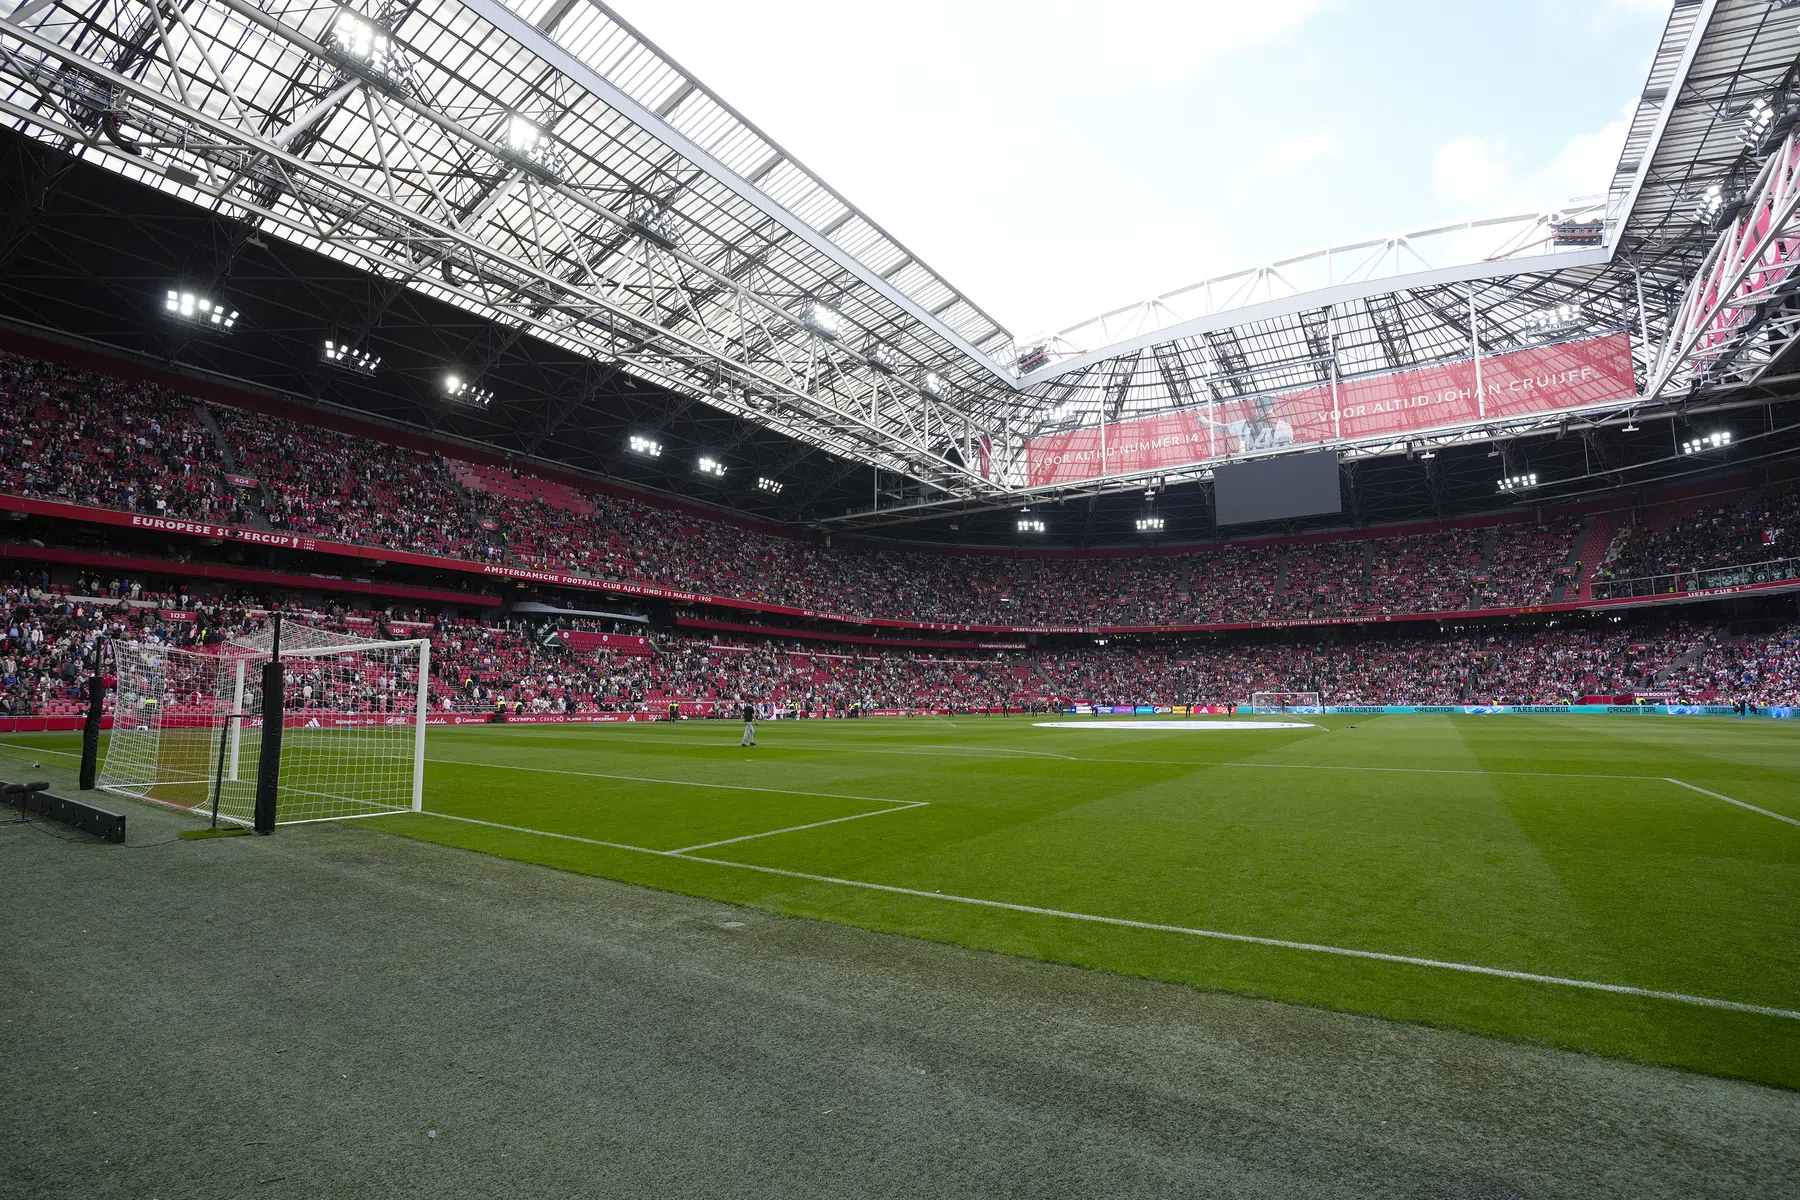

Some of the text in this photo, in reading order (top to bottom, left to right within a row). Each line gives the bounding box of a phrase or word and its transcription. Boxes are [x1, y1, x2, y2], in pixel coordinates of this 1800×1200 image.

[1317, 367, 1598, 422] VOOR ALTIJD JOHAN CRUIJFF.
[1035, 451, 1071, 468] VOOR
[1075, 447, 1115, 462] ALTID
[1120, 435, 1180, 455] NUMMER
[234, 477, 249, 485] 404
[132, 516, 211, 535] EUROPESE
[484, 565, 559, 582] AMSTERDAMSCHE
[562, 576, 601, 588] FOOTBALL
[602, 582, 621, 590] CLUB
[623, 584, 642, 593] AJAX
[643, 587, 662, 596] SINDS
[673, 591, 696, 600] MAART
[698, 595, 712, 603] 1900
[1687, 589, 1712, 597] UEFA
[1713, 587, 1733, 595] CUP
[170, 612, 186, 620] 103
